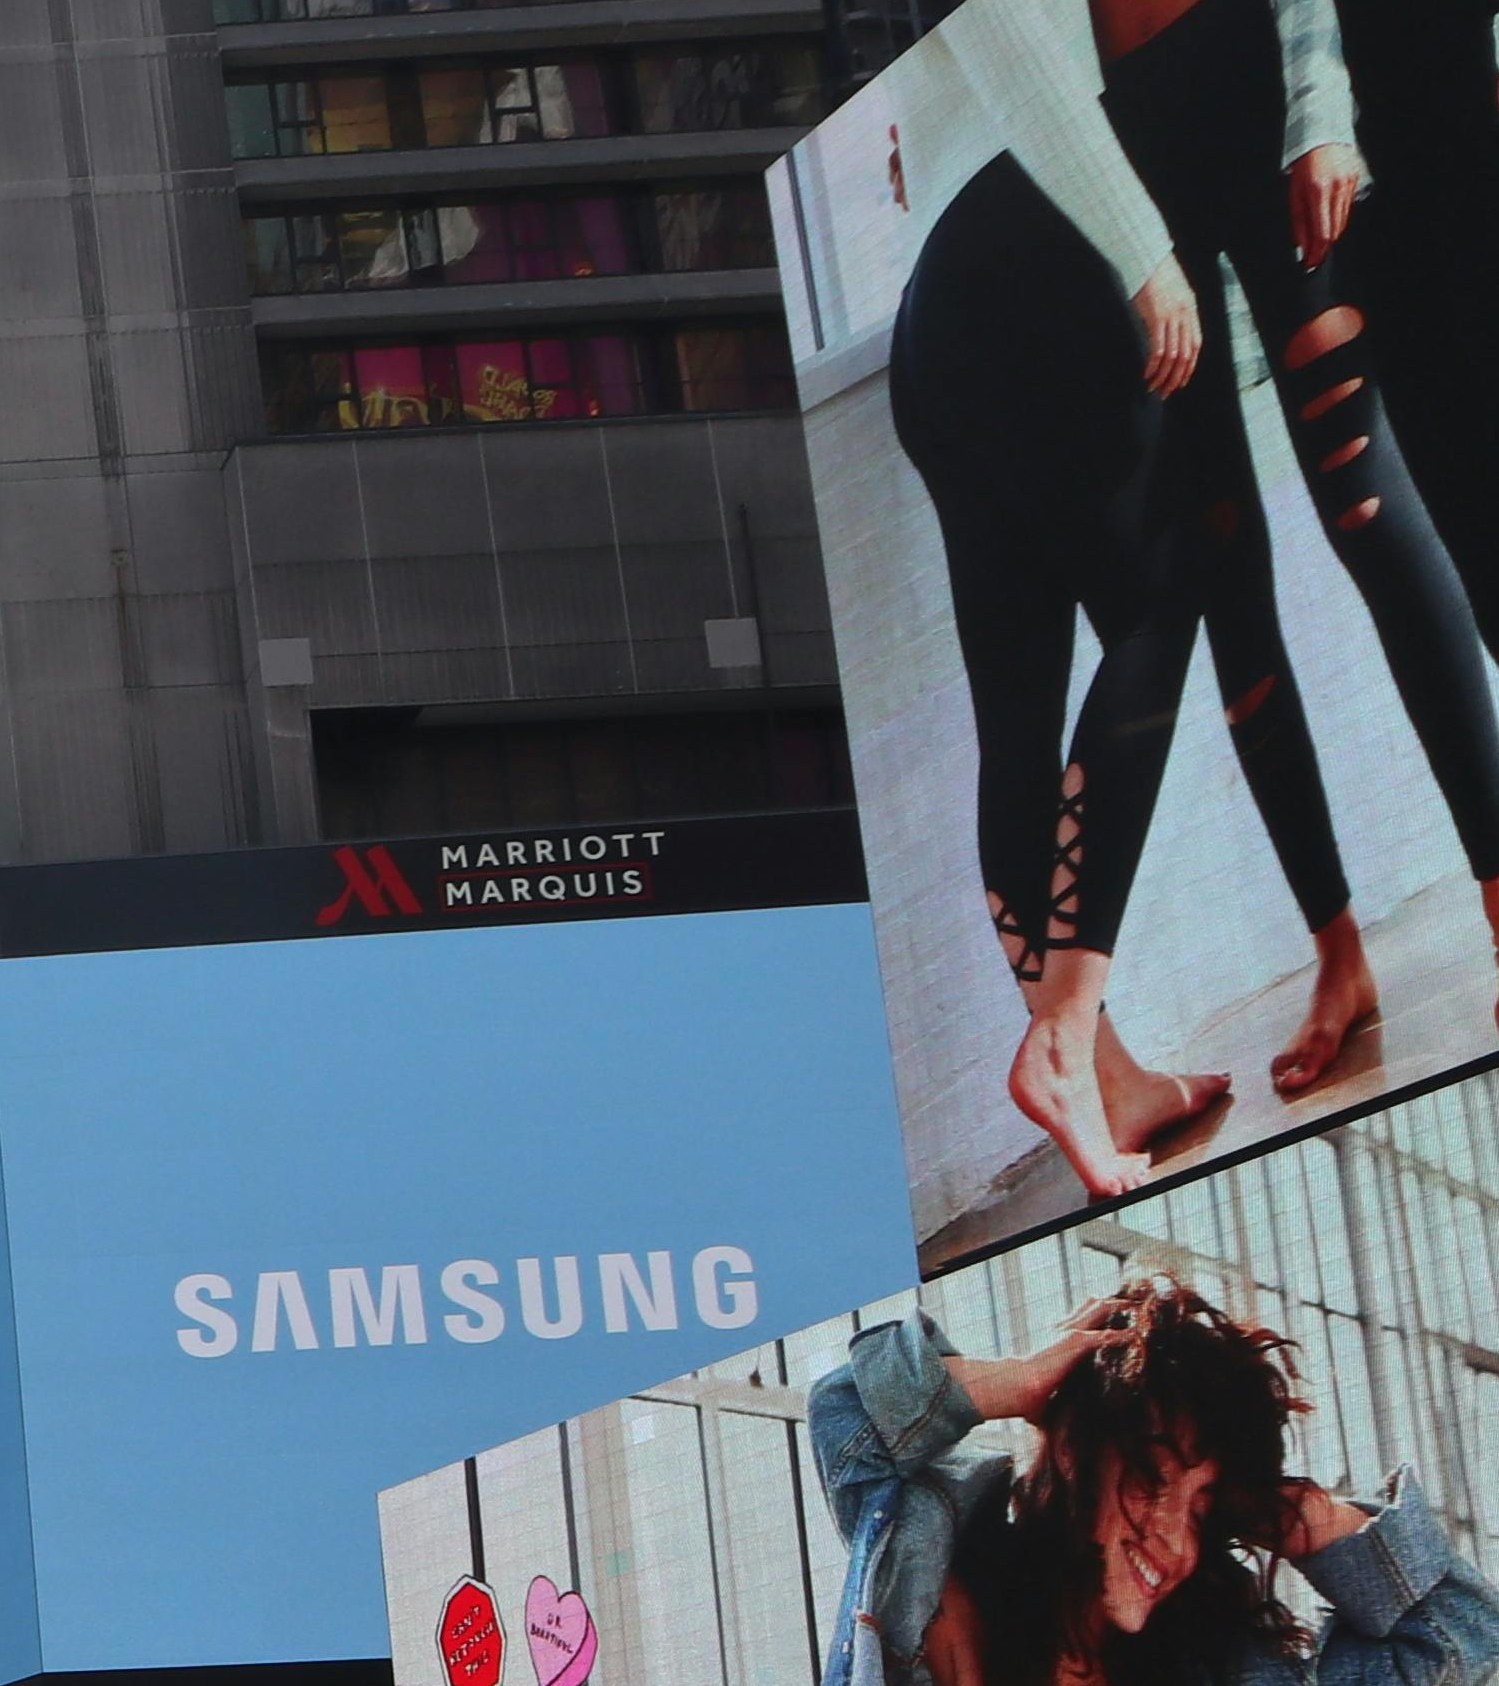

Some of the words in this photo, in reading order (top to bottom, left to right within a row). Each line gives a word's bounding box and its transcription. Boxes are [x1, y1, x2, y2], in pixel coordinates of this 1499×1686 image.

[440, 832, 665, 870] MARRIOTT
[444, 869, 645, 907] MARQUIS
[173, 1245, 758, 1358] SAMSUNG
